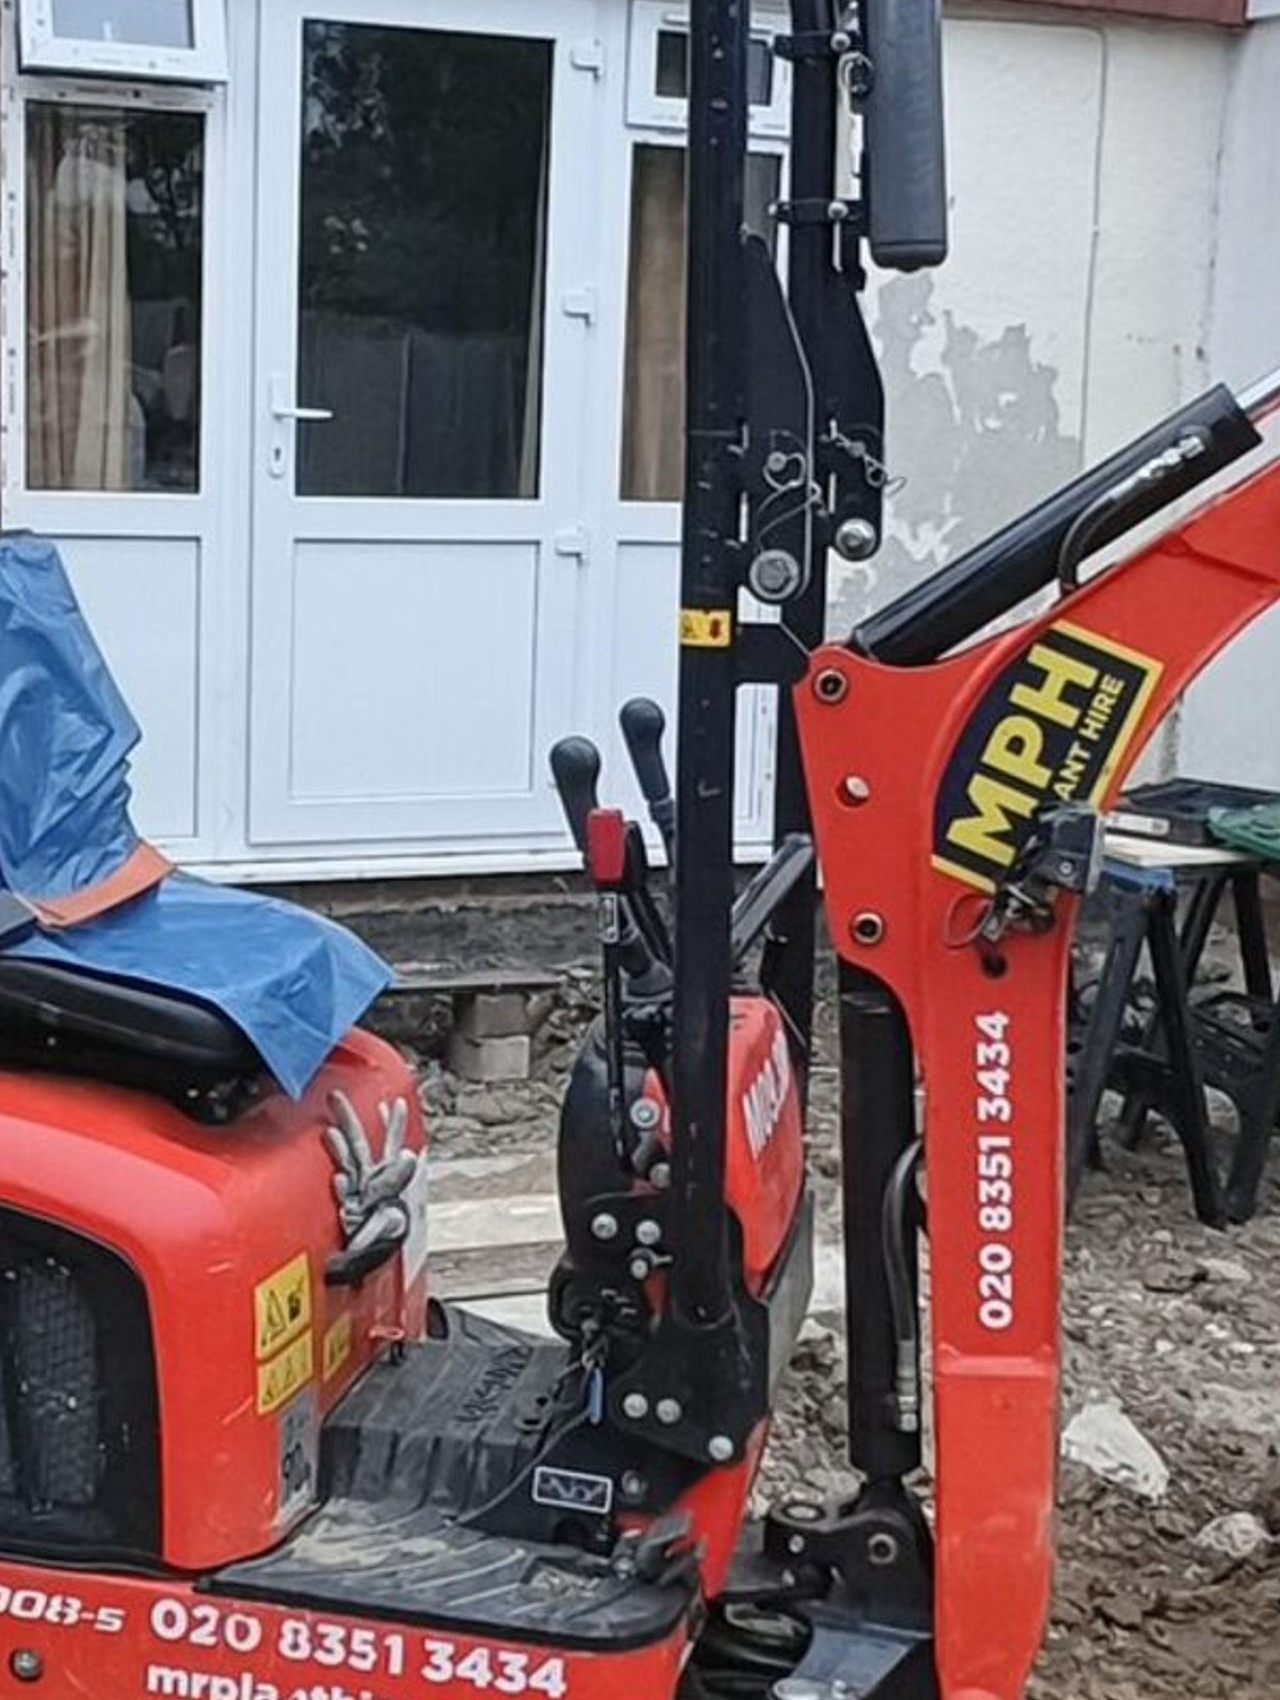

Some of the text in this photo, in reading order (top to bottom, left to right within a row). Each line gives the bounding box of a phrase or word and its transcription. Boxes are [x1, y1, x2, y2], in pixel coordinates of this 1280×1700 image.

[946, 644, 1099, 867] MPH
[1053, 674, 1125, 800] ANT HIRE
[975, 1011, 1013, 1329] 020 8351 3434
[150, 1599, 568, 1700] 020 8351 3434
